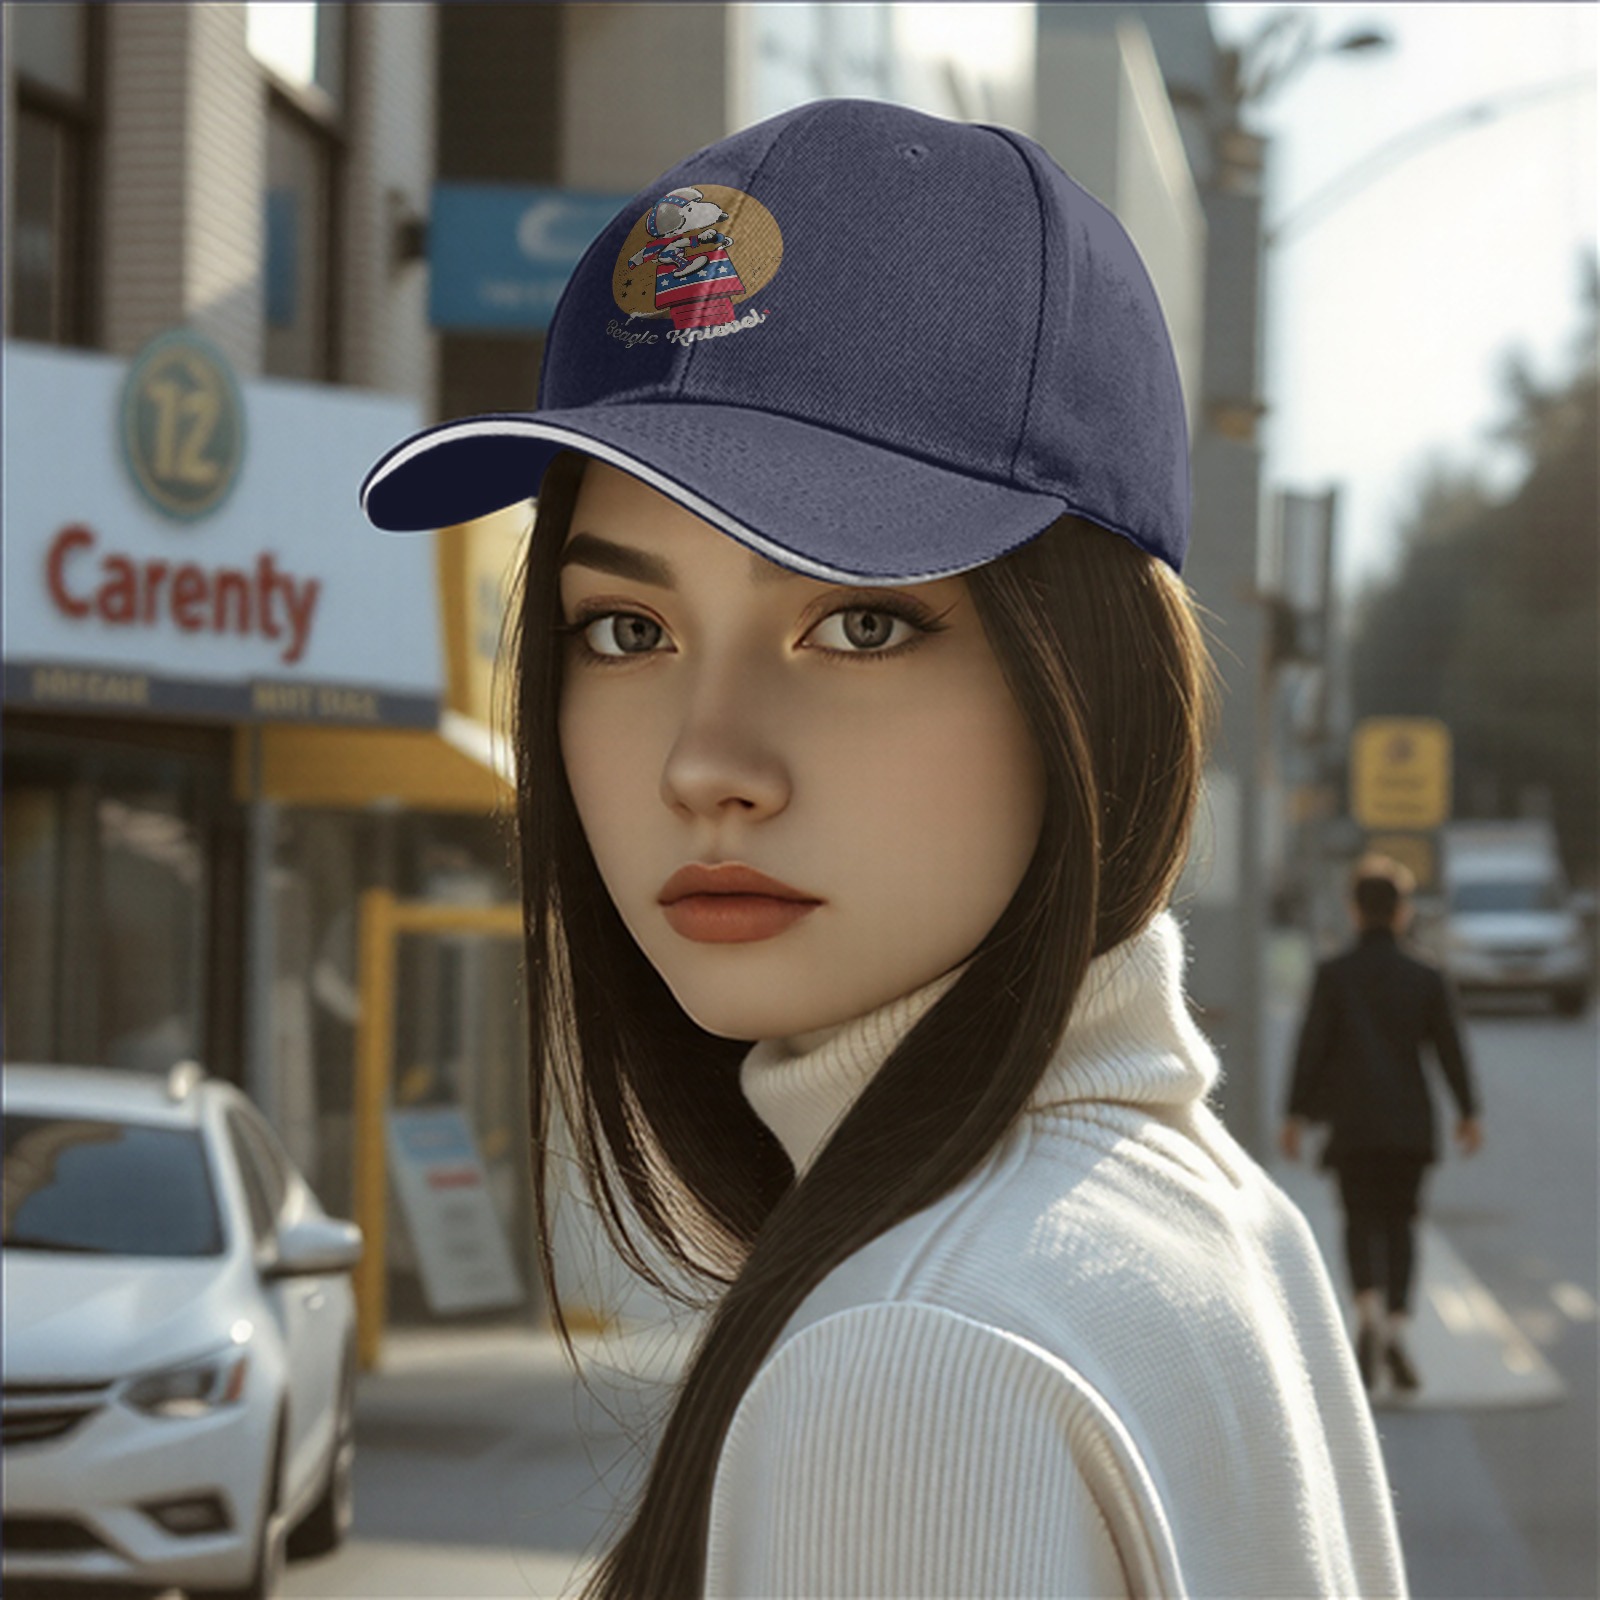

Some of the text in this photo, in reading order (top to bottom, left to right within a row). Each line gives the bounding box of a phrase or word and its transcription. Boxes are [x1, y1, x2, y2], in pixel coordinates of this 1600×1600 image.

[605, 318, 659, 349] Beagle
[146, 380, 220, 486] 12
[45, 522, 321, 665] Carenty
